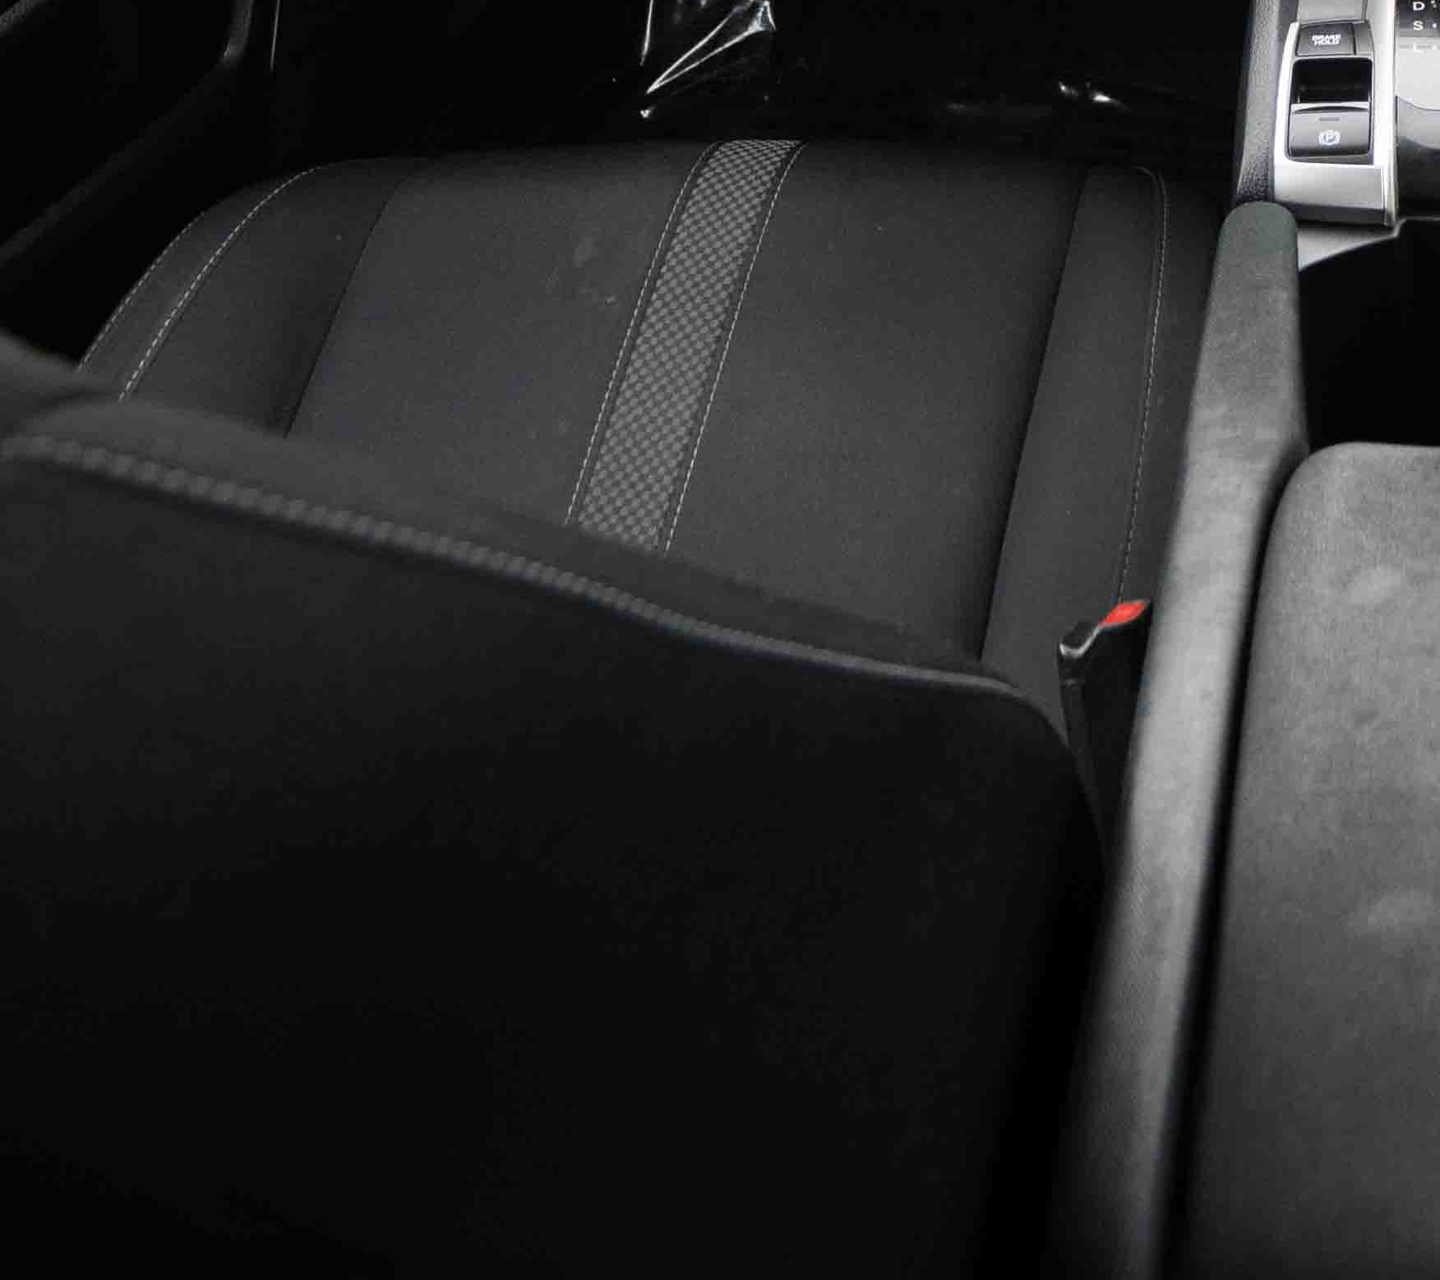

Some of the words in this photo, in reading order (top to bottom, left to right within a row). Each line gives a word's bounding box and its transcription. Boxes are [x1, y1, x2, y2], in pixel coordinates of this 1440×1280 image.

[1412, 1, 1425, 11] D
[1412, 20, 1424, 31] S
[1311, 33, 1342, 41] BRAKE
